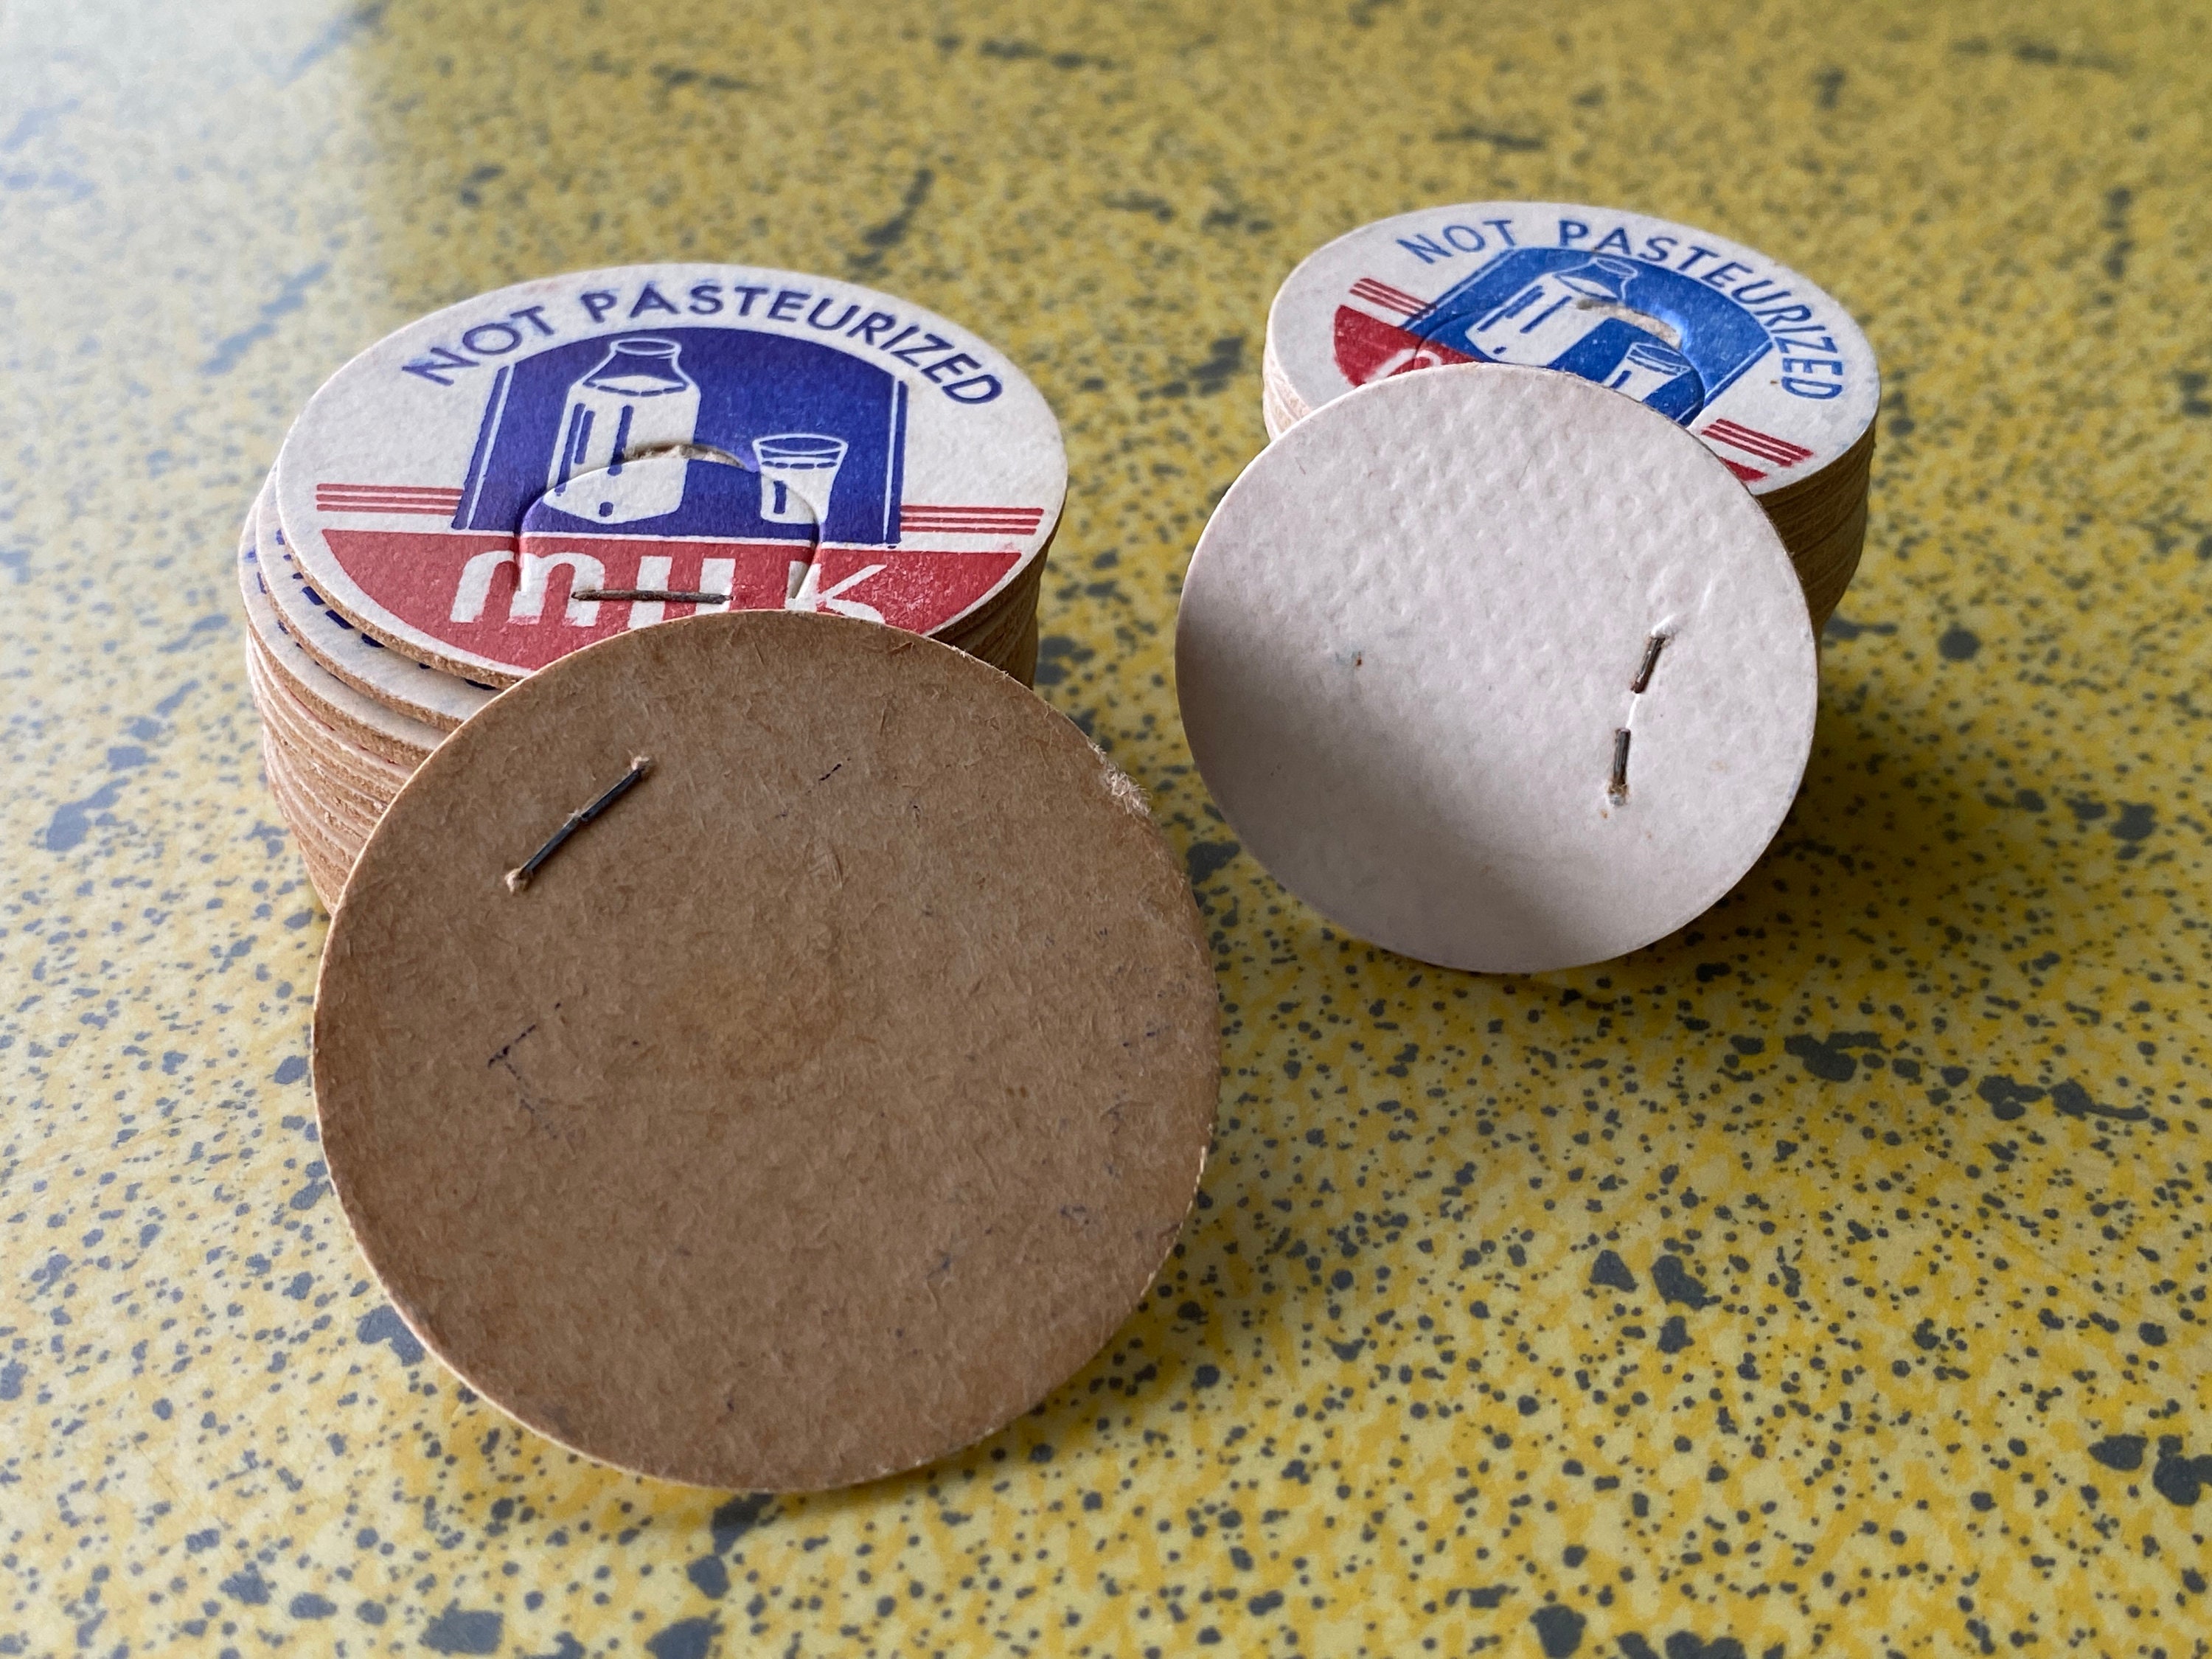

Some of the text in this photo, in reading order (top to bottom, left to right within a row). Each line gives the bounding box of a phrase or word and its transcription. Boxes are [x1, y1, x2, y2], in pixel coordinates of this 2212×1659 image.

[401, 281, 1003, 404] NOT PASTEURIZED
[1396, 219, 1844, 400] NOT PASTEURIZED
